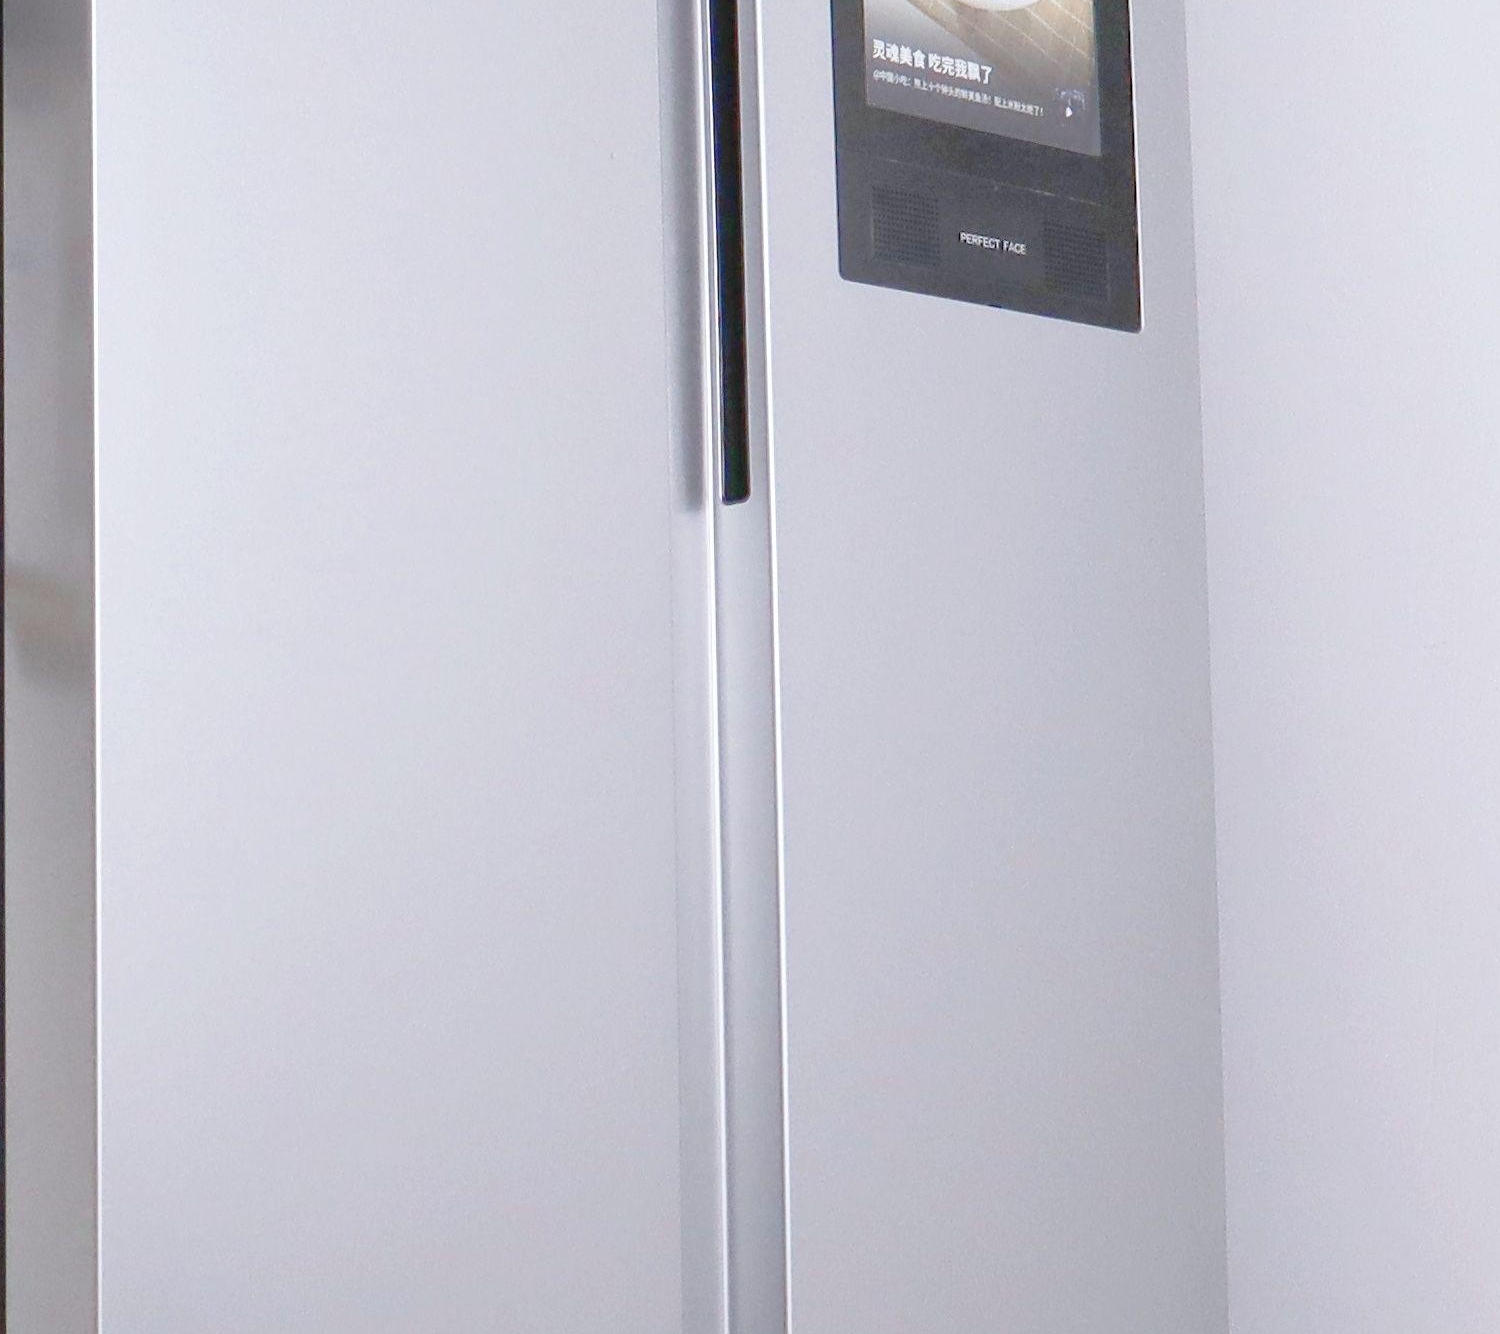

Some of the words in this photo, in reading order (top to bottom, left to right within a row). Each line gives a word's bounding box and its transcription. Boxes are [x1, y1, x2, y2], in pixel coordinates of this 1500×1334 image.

[872, 38, 927, 70] 灵魂美食
[927, 52, 993, 85] 吃完我飘了
[959, 231, 1000, 249] PERFECT
[1003, 240, 1027, 255] FACE
